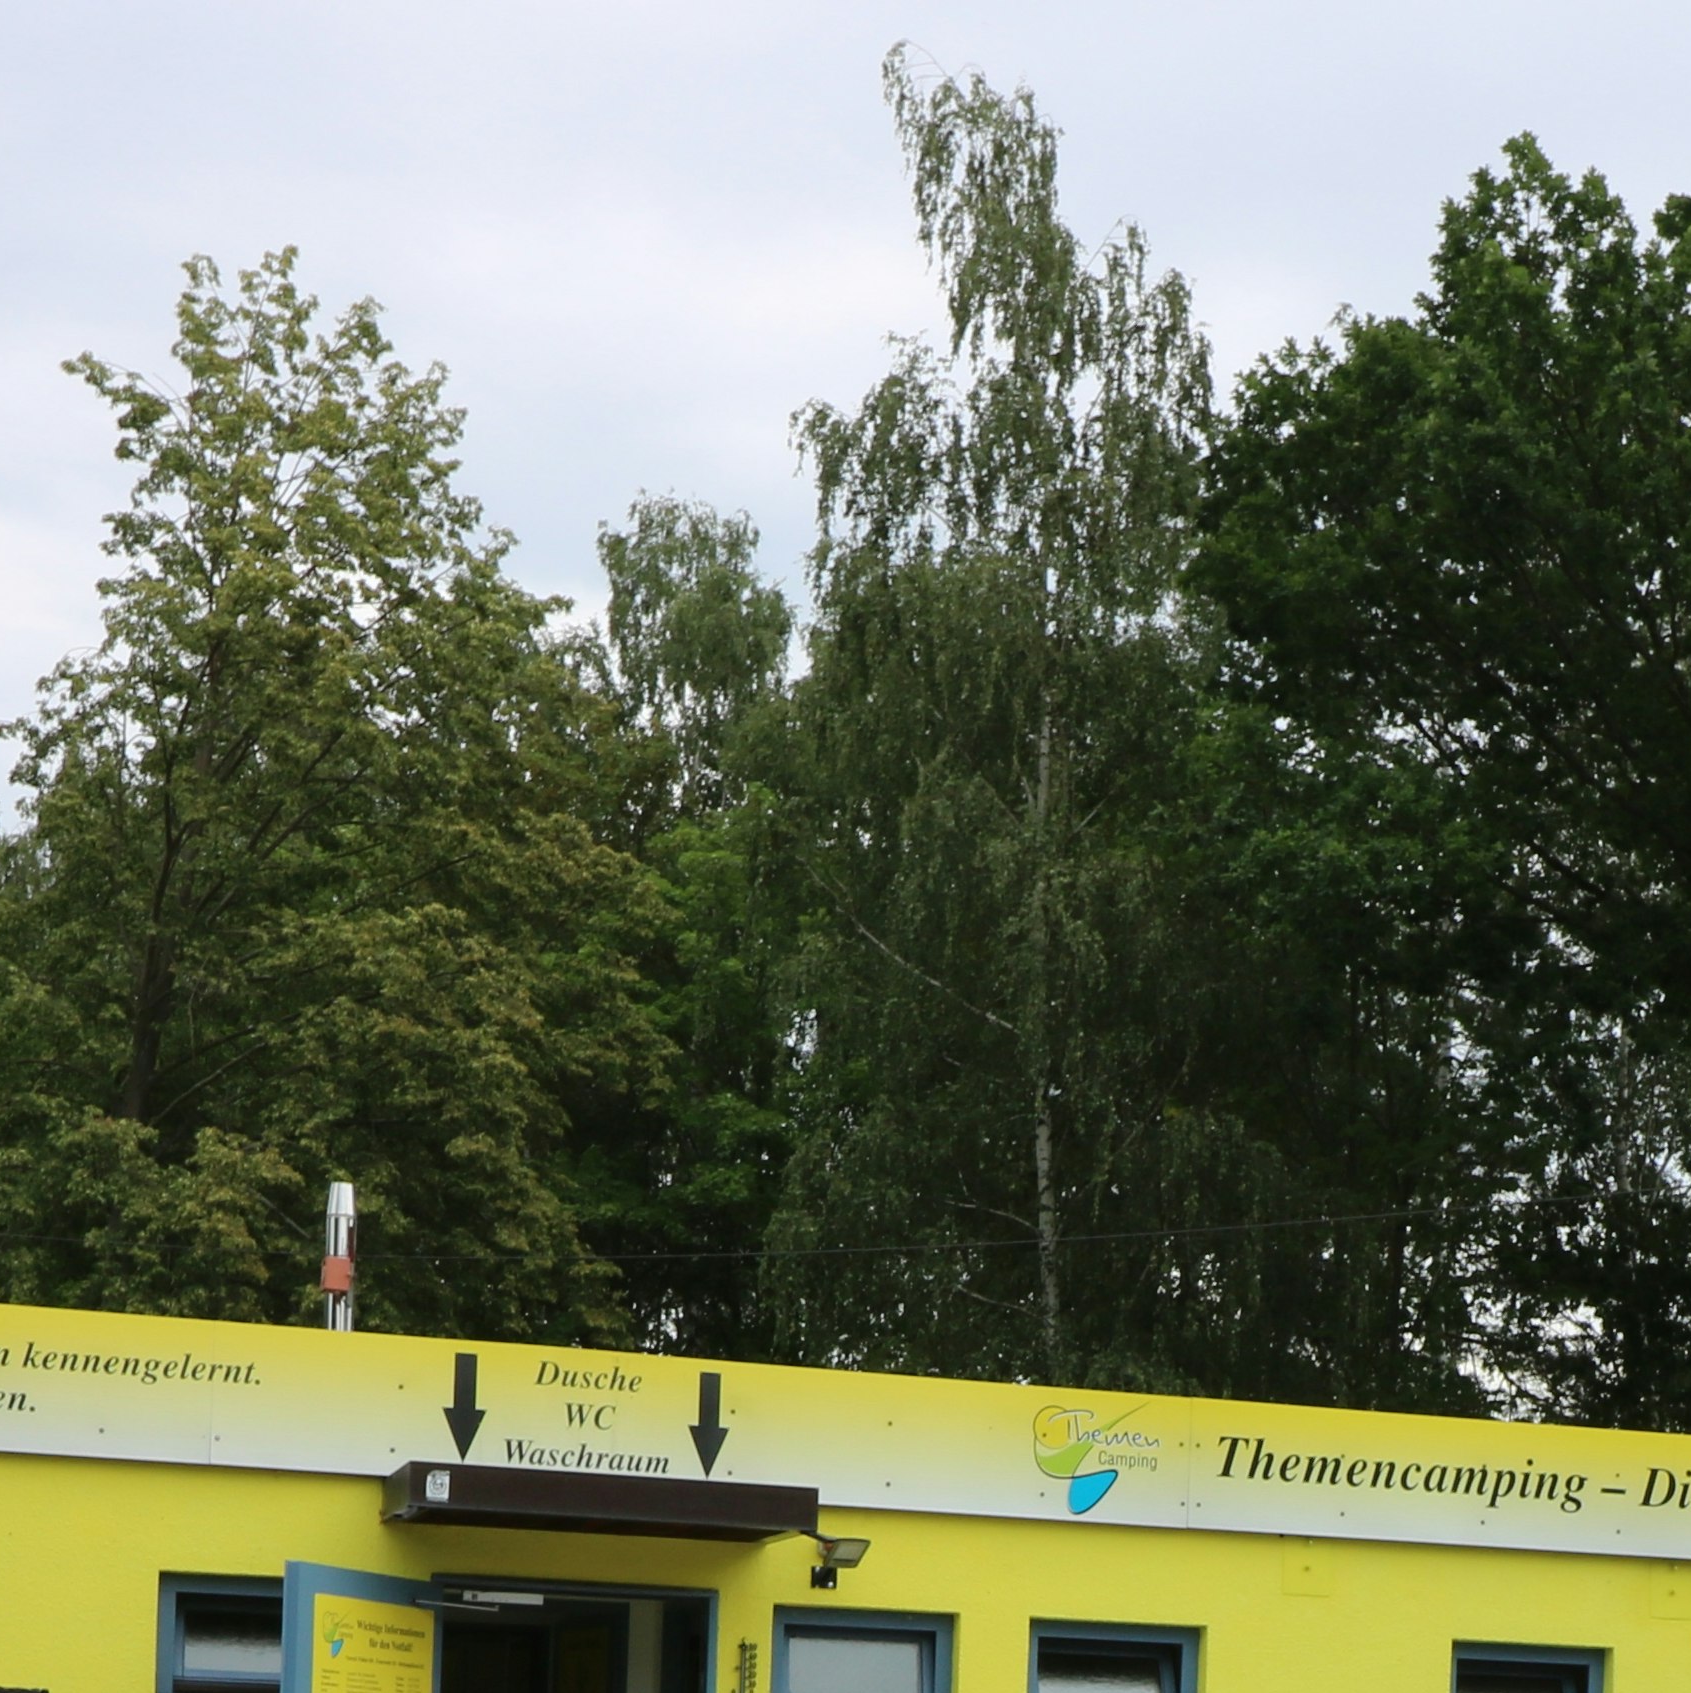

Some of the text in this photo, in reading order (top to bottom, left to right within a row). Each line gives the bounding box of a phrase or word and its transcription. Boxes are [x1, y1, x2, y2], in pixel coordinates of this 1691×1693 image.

[21, 1342, 264, 1388] kennengelernt.
[534, 1360, 643, 1394] Dusche
[564, 1402, 617, 1431] WC
[1047, 1408, 1160, 1448] Themen
[503, 1438, 671, 1475] Waschraum
[1098, 1450, 1158, 1472] Camping
[1215, 1434, 1590, 1512] Themencamping
[356, 1620, 383, 1635] Wichtige
[384, 1624, 426, 1639] Informationen
